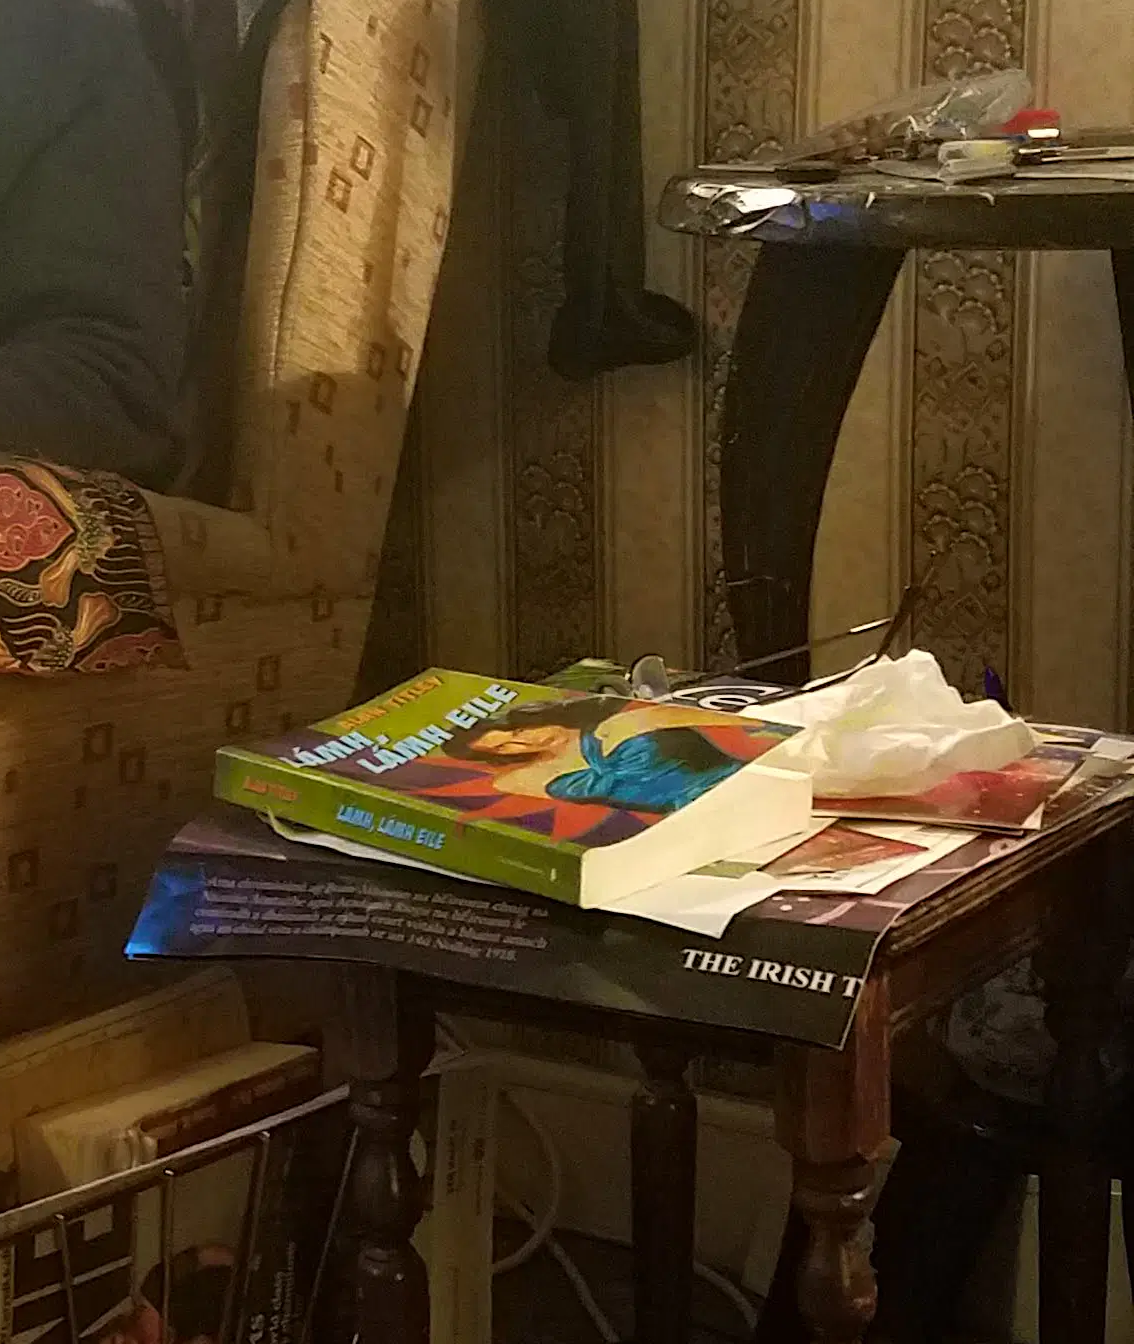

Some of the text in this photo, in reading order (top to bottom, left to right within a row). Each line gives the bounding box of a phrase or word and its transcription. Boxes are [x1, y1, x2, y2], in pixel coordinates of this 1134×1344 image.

[338, 706, 389, 731] ALAN
[444, 682, 520, 731] EILE
[414, 827, 447, 851] EILE
[680, 947, 744, 977] THE
[746, 958, 838, 994] IRISH
